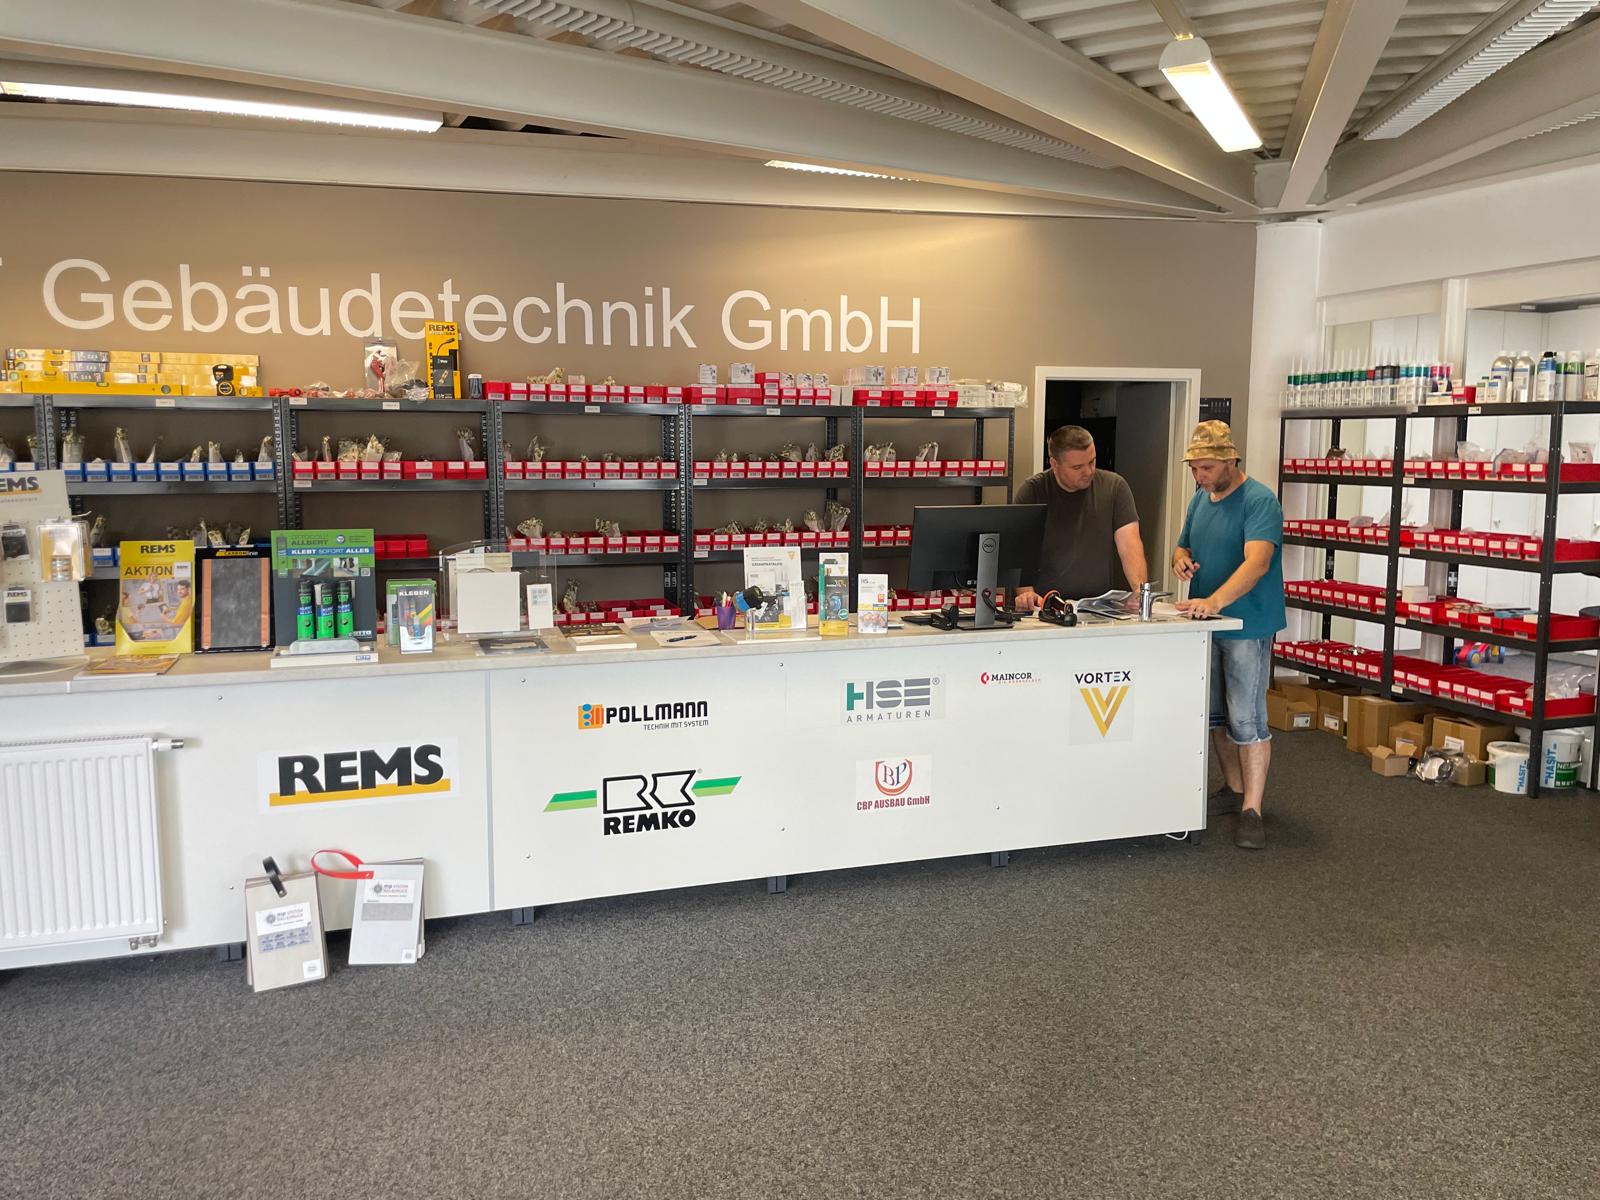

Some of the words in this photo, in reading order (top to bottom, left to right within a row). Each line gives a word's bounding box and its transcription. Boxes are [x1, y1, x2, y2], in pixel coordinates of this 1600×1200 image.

[42, 258, 698, 349] Gebäudetechnik
[721, 289, 921, 355] GmbH
[428, 324, 456, 332] REMS
[140, 544, 176, 554] REMS
[124, 565, 173, 576] AKTION
[990, 672, 1033, 681] MAINCOR
[1074, 670, 1132, 685] VORTEX
[846, 677, 931, 712] HSE
[605, 700, 708, 724] POLLMANN
[846, 709, 931, 724] ARMATUREN
[643, 722, 670, 732] TECHNIK
[670, 721, 683, 729] MIT
[683, 719, 709, 728] SYSTEM
[277, 743, 444, 797] REMS
[1545, 748, 1556, 780] HASIT
[1518, 764, 1527, 788] HASIT
[856, 800, 873, 811] CBP
[873, 797, 906, 809] AUSBAU
[906, 795, 931, 806] GmbH
[603, 808, 697, 836] REMKO
